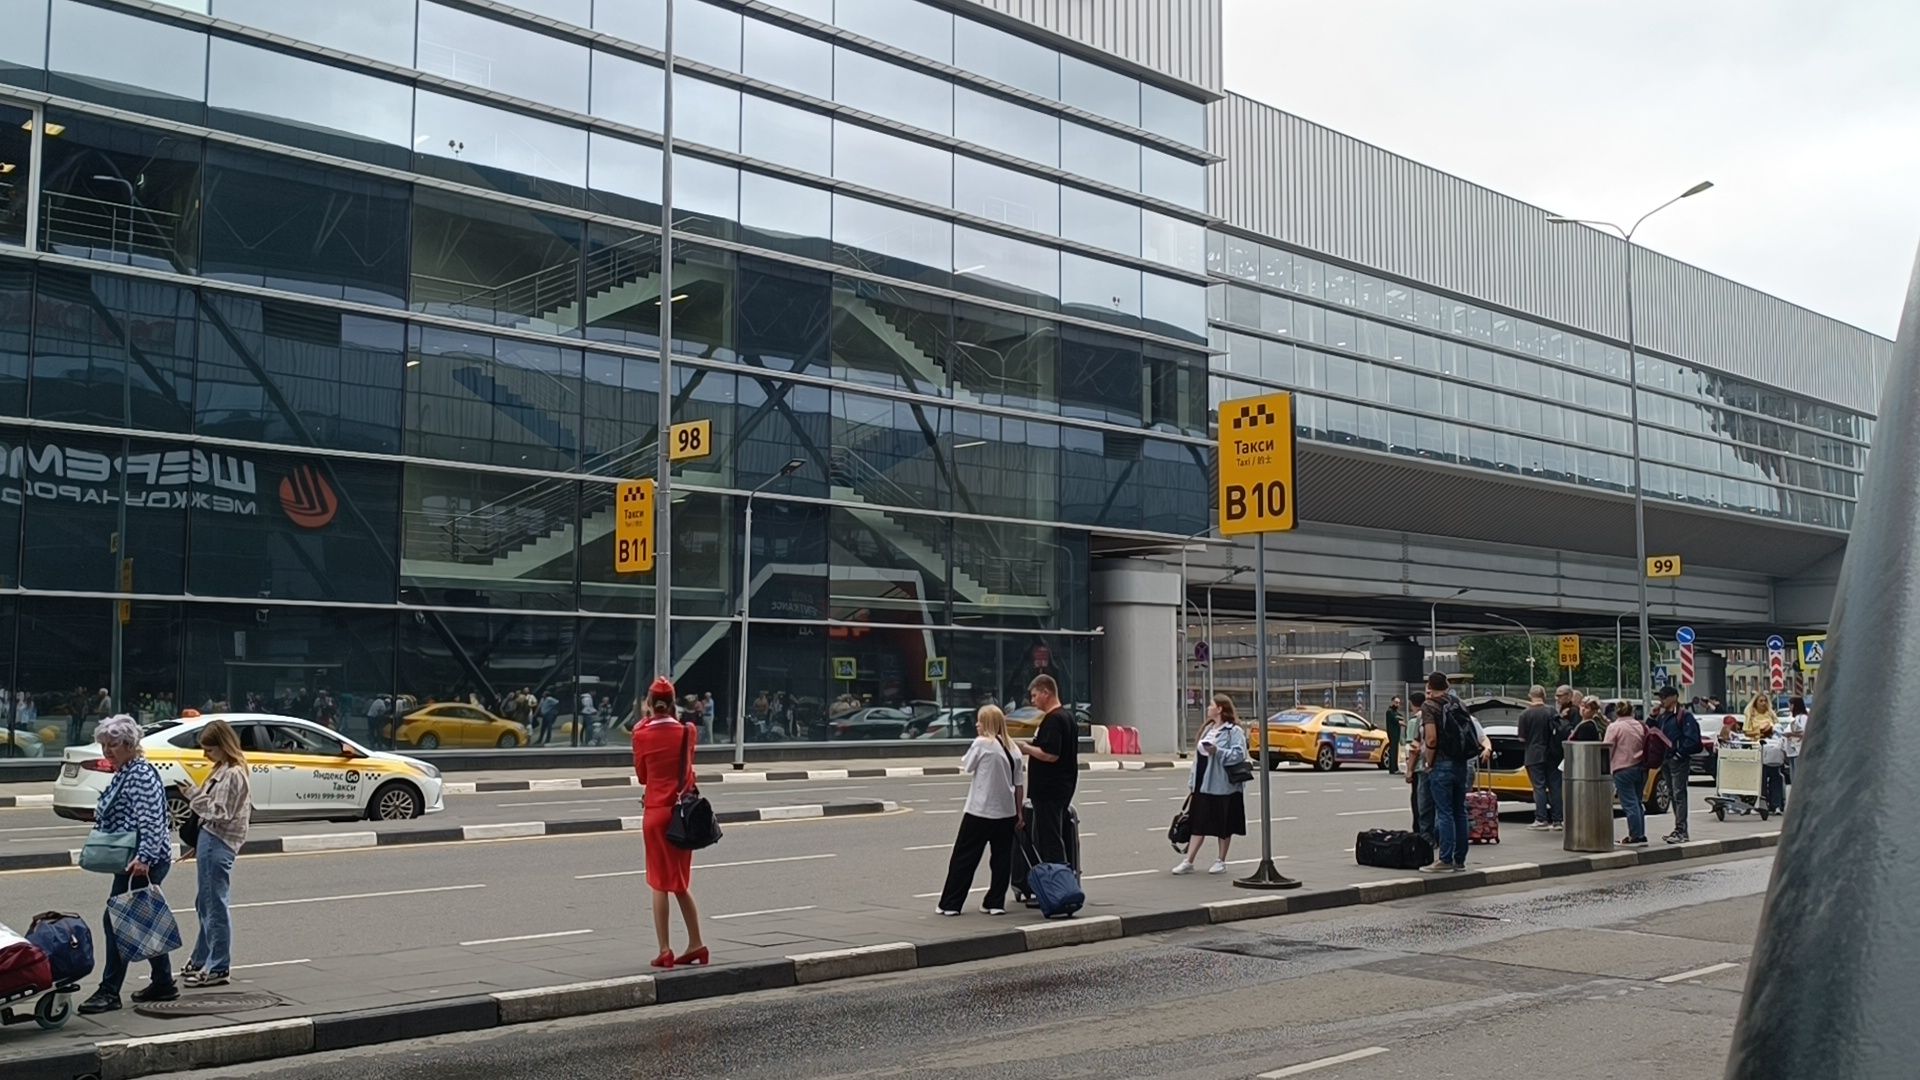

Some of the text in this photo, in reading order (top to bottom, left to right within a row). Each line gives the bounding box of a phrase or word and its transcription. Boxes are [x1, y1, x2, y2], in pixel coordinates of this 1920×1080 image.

[678, 427, 701, 452] 98
[1234, 439, 1274, 455] Такси
[1236, 458, 1251, 467] Taxi
[624, 508, 644, 520] Такси
[619, 537, 647, 563] B11
[1654, 559, 1673, 573] 99
[312, 769, 359, 782] Яндекс Go
[333, 781, 357, 792] Такси
[303, 792, 320, 800] (495)
